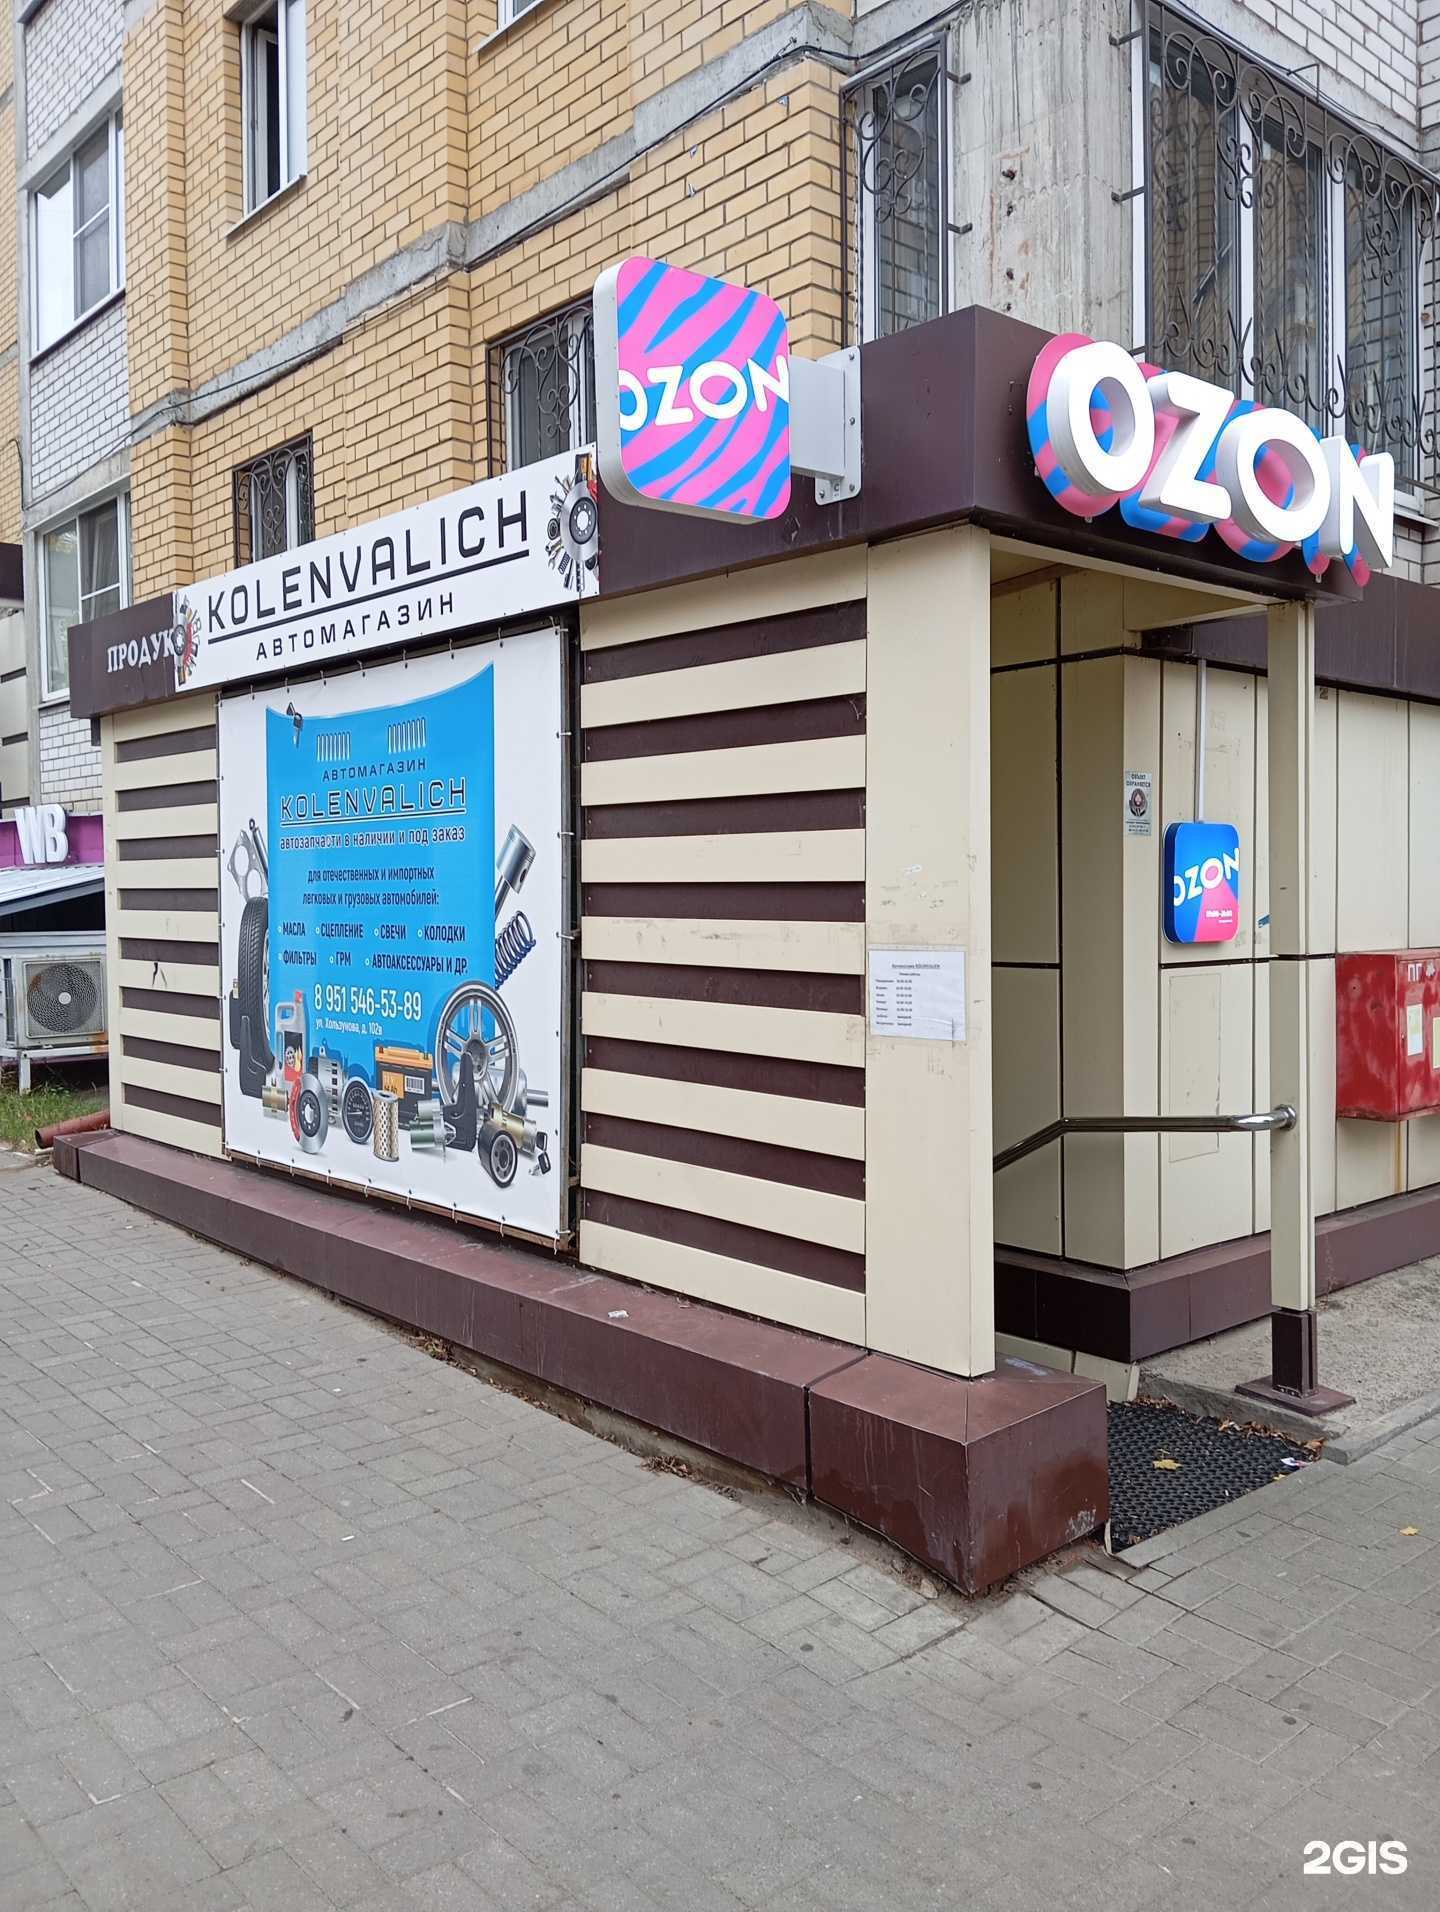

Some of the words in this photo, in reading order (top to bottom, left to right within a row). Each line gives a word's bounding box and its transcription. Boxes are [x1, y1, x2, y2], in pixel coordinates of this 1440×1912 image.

[618, 355, 789, 432] OZON
[1046, 340, 1395, 568] OZON
[206, 489, 529, 634] KOLENVALICH
[255, 591, 455, 662] АВТОМАГАЗИН
[322, 758, 427, 782] АВТОМАГАЗИН
[280, 777, 467, 820] KOLENVALICH
[15, 803, 69, 865] WB
[280, 834, 342, 850] автозапчасти
[344, 834, 350, 847] в
[352, 831, 395, 847] наличии
[399, 831, 405, 844] и
[409, 829, 428, 846] под
[432, 826, 465, 842] заказ
[307, 869, 322, 885] для
[322, 867, 380, 882] отечественных
[381, 868, 387, 880] и
[388, 866, 435, 883] импортных
[1173, 848, 1240, 907] OZON
[302, 892, 336, 905] легковых
[337, 892, 343, 904] и
[344, 892, 381, 908] грузовых
[382, 888, 440, 906] автомобилей:
[282, 922, 306, 937] МАСЛА
[320, 923, 364, 939] СЦЕПЛЕНИЕ
[380, 924, 406, 939] СВЕЧИ
[424, 925, 466, 943] КОЛОДКИ
[282, 951, 317, 966] ФИЛЬТРЫ
[335, 952, 352, 967] ГРМ
[372, 954, 444, 972] АВТОАКСЕССУАРЫ
[446, 958, 453, 973] И
[314, 984, 322, 1011] 8
[326, 984, 347, 1013] 951
[350, 986, 422, 1021] 546-53-89
